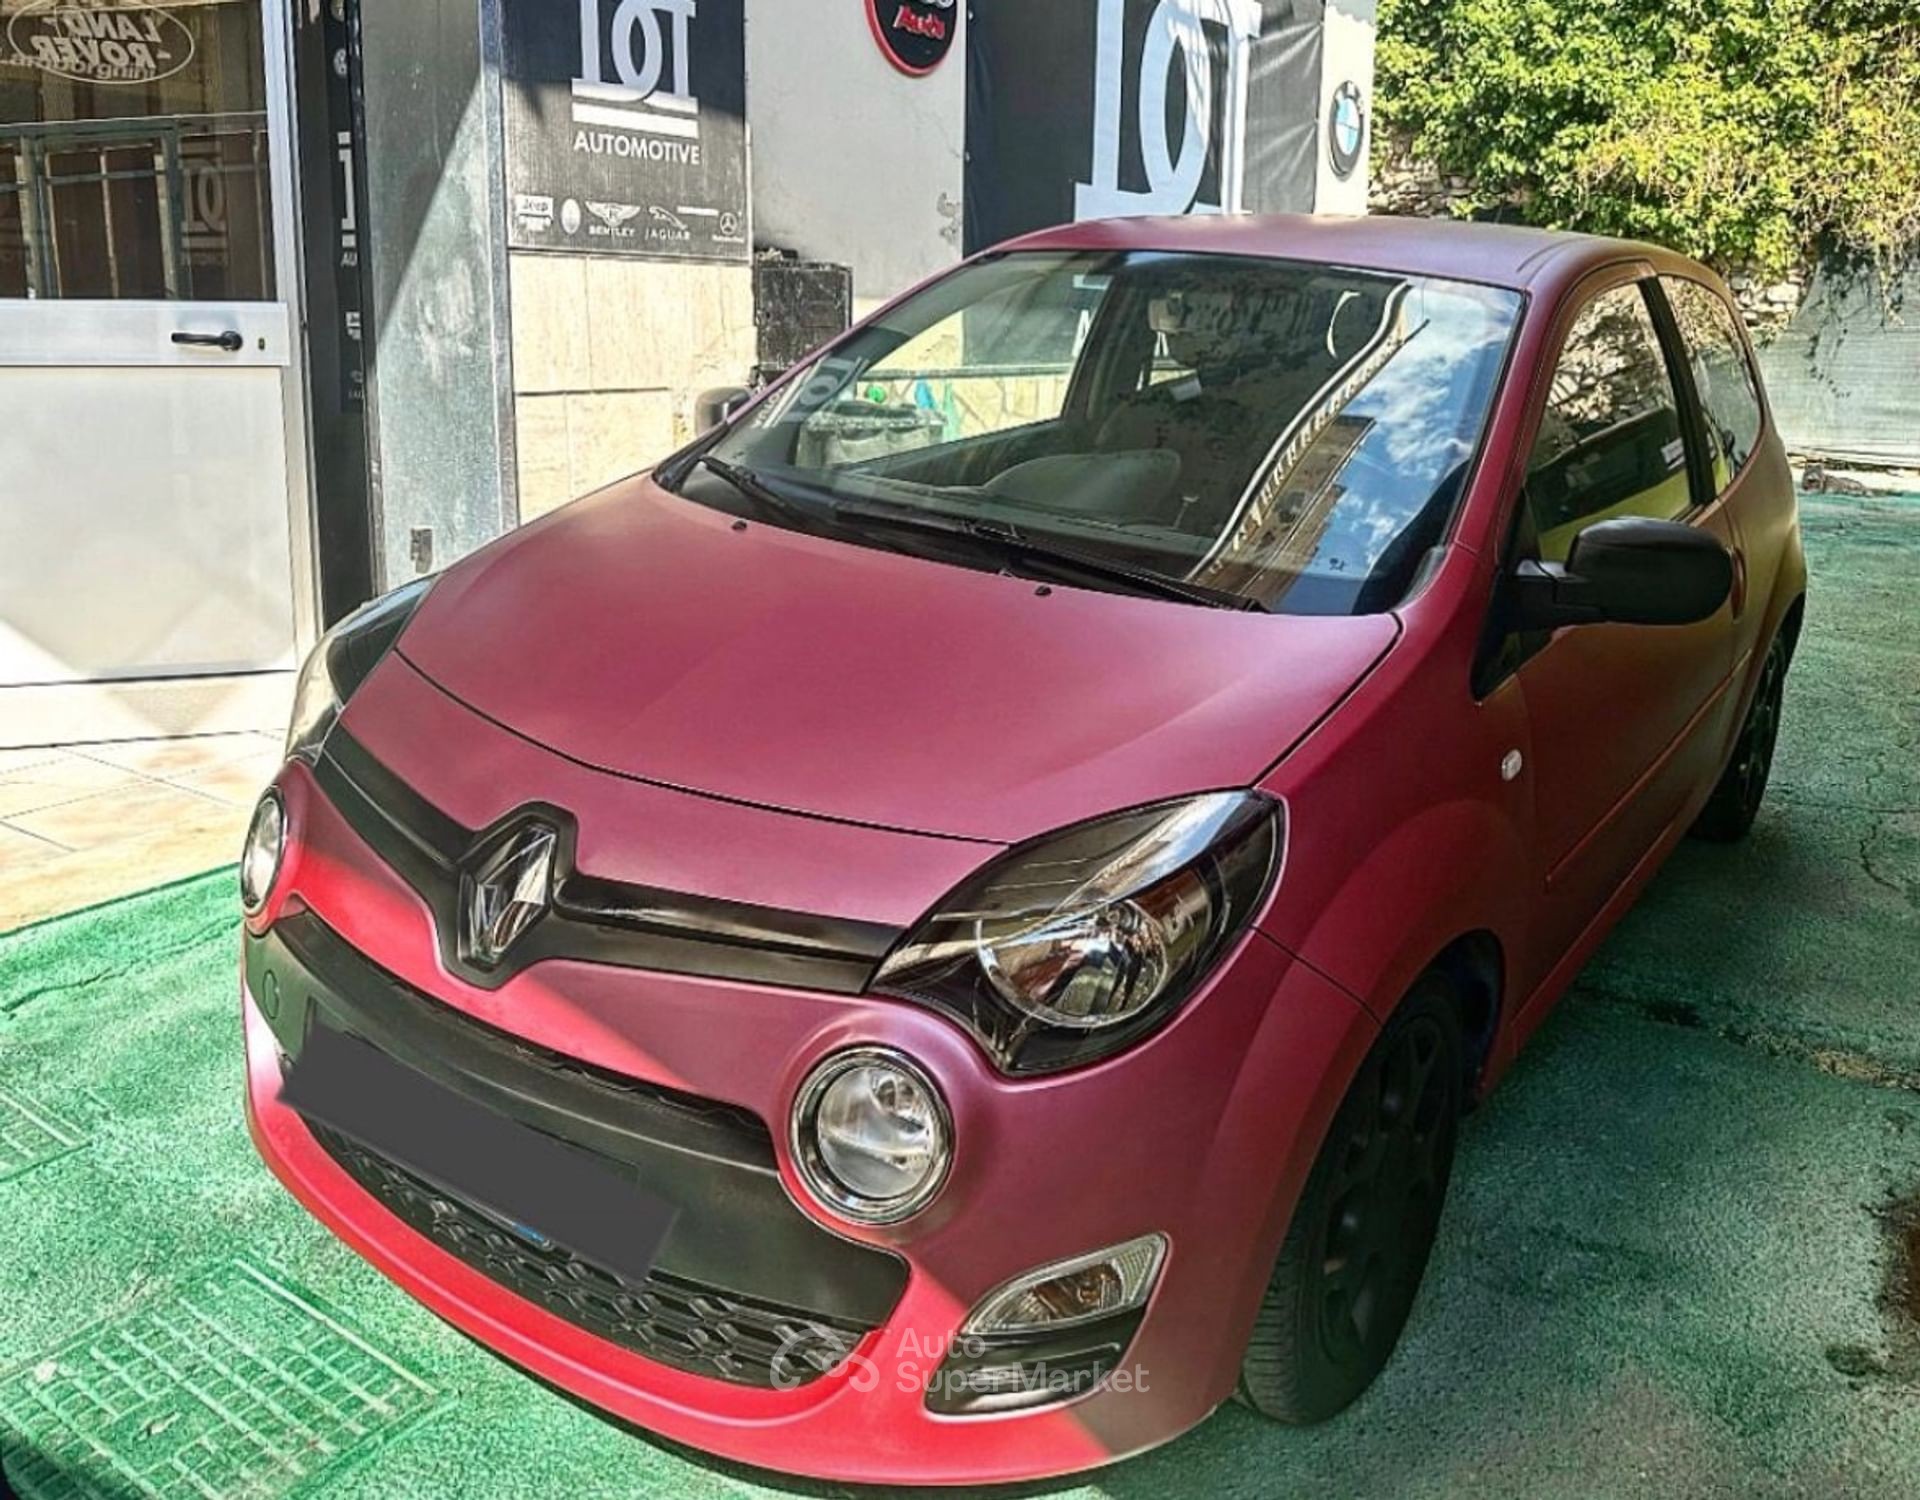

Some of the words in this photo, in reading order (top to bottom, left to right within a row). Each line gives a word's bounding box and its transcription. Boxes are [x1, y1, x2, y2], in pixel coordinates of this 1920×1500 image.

[573, 130, 700, 165] AUTOMOTIVE
[588, 225, 636, 239] BENTLEY
[644, 228, 692, 241] JAGUAR
